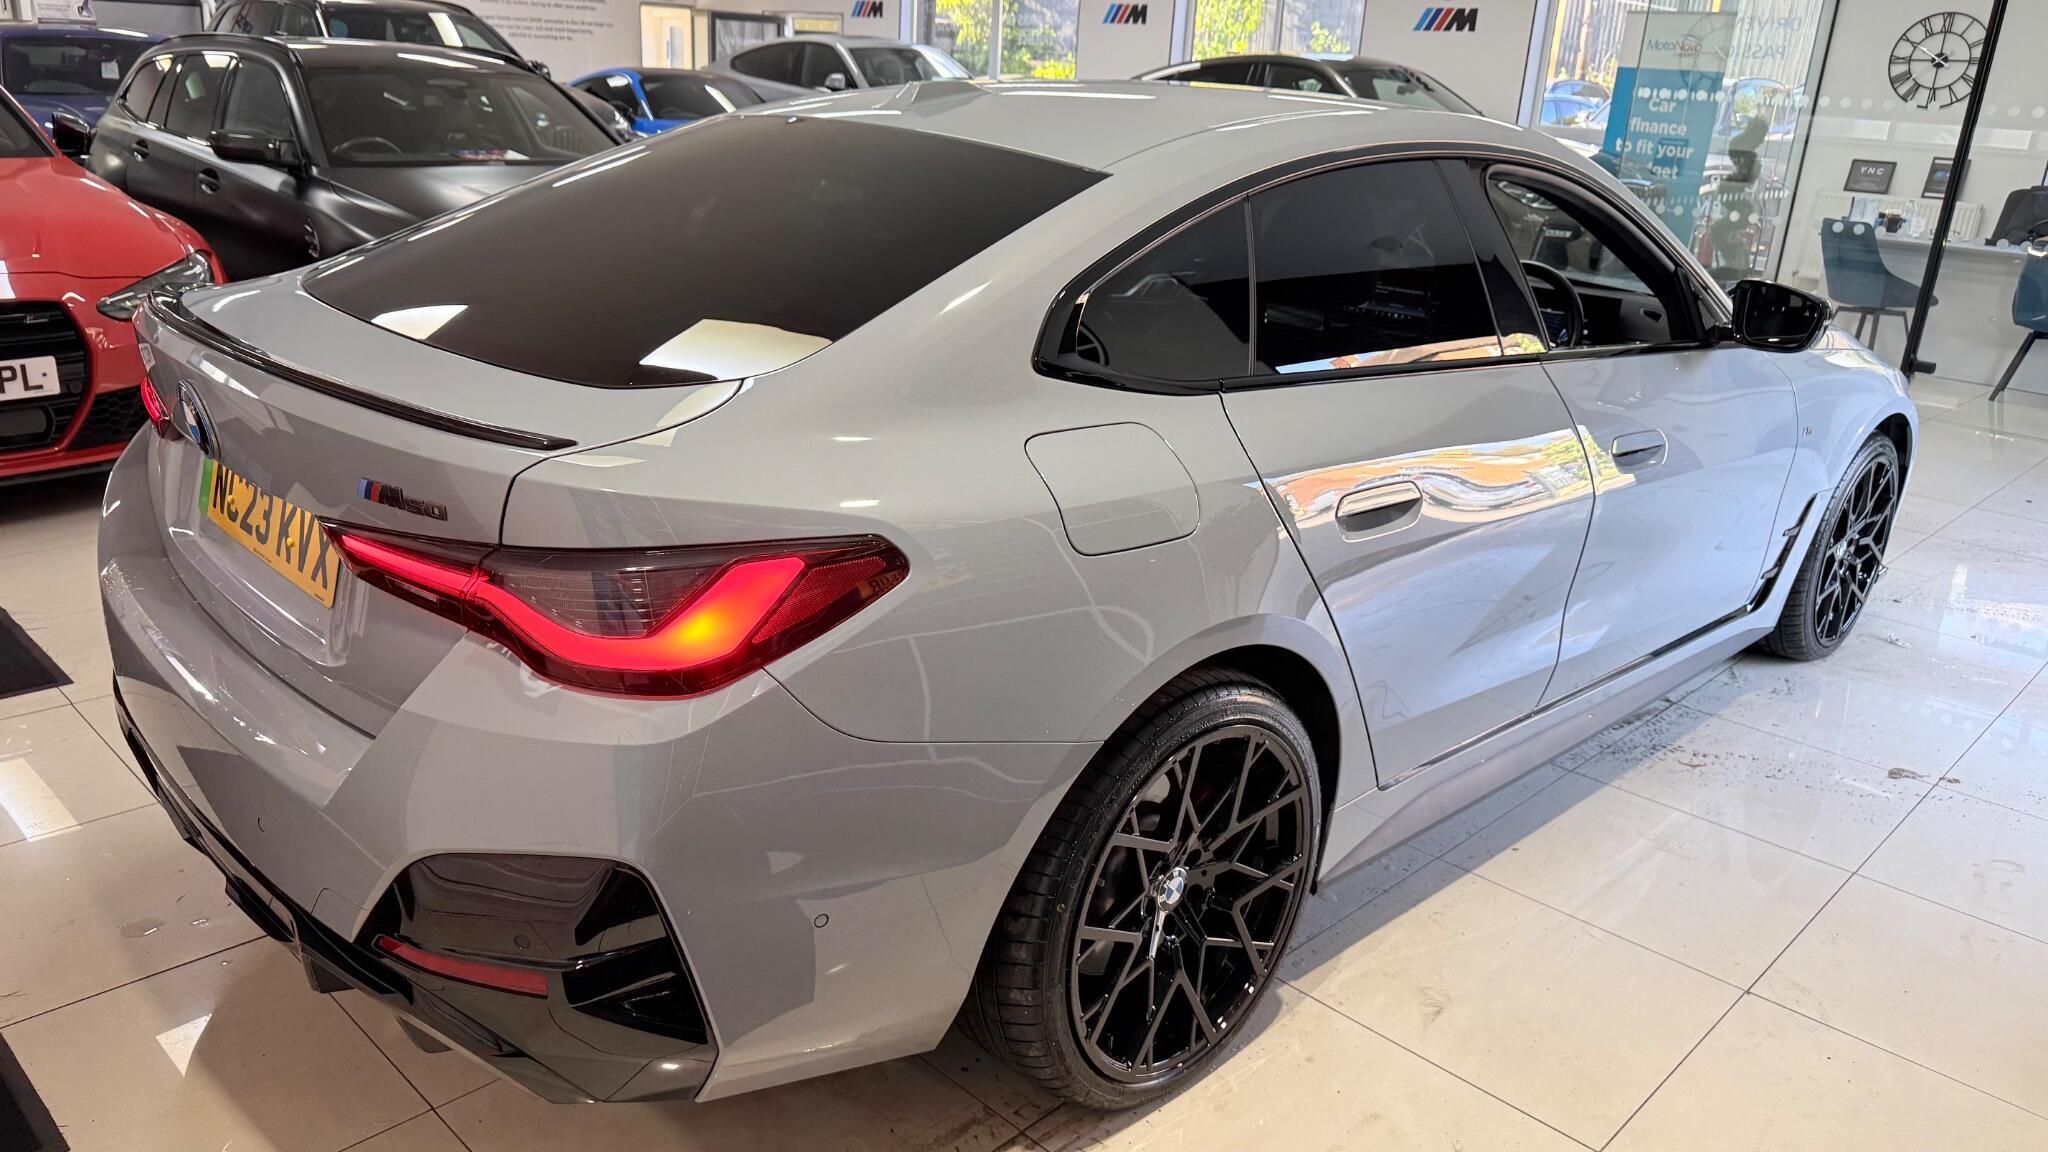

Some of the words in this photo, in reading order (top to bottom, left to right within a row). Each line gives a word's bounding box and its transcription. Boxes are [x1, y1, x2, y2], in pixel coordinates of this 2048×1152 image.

[1649, 98, 1677, 113] Car
[1630, 117, 1687, 136] finance
[1615, 137, 1632, 152] to
[1637, 139, 1654, 154] fit
[1656, 142, 1694, 159] your
[275, 500, 332, 591] KVX
